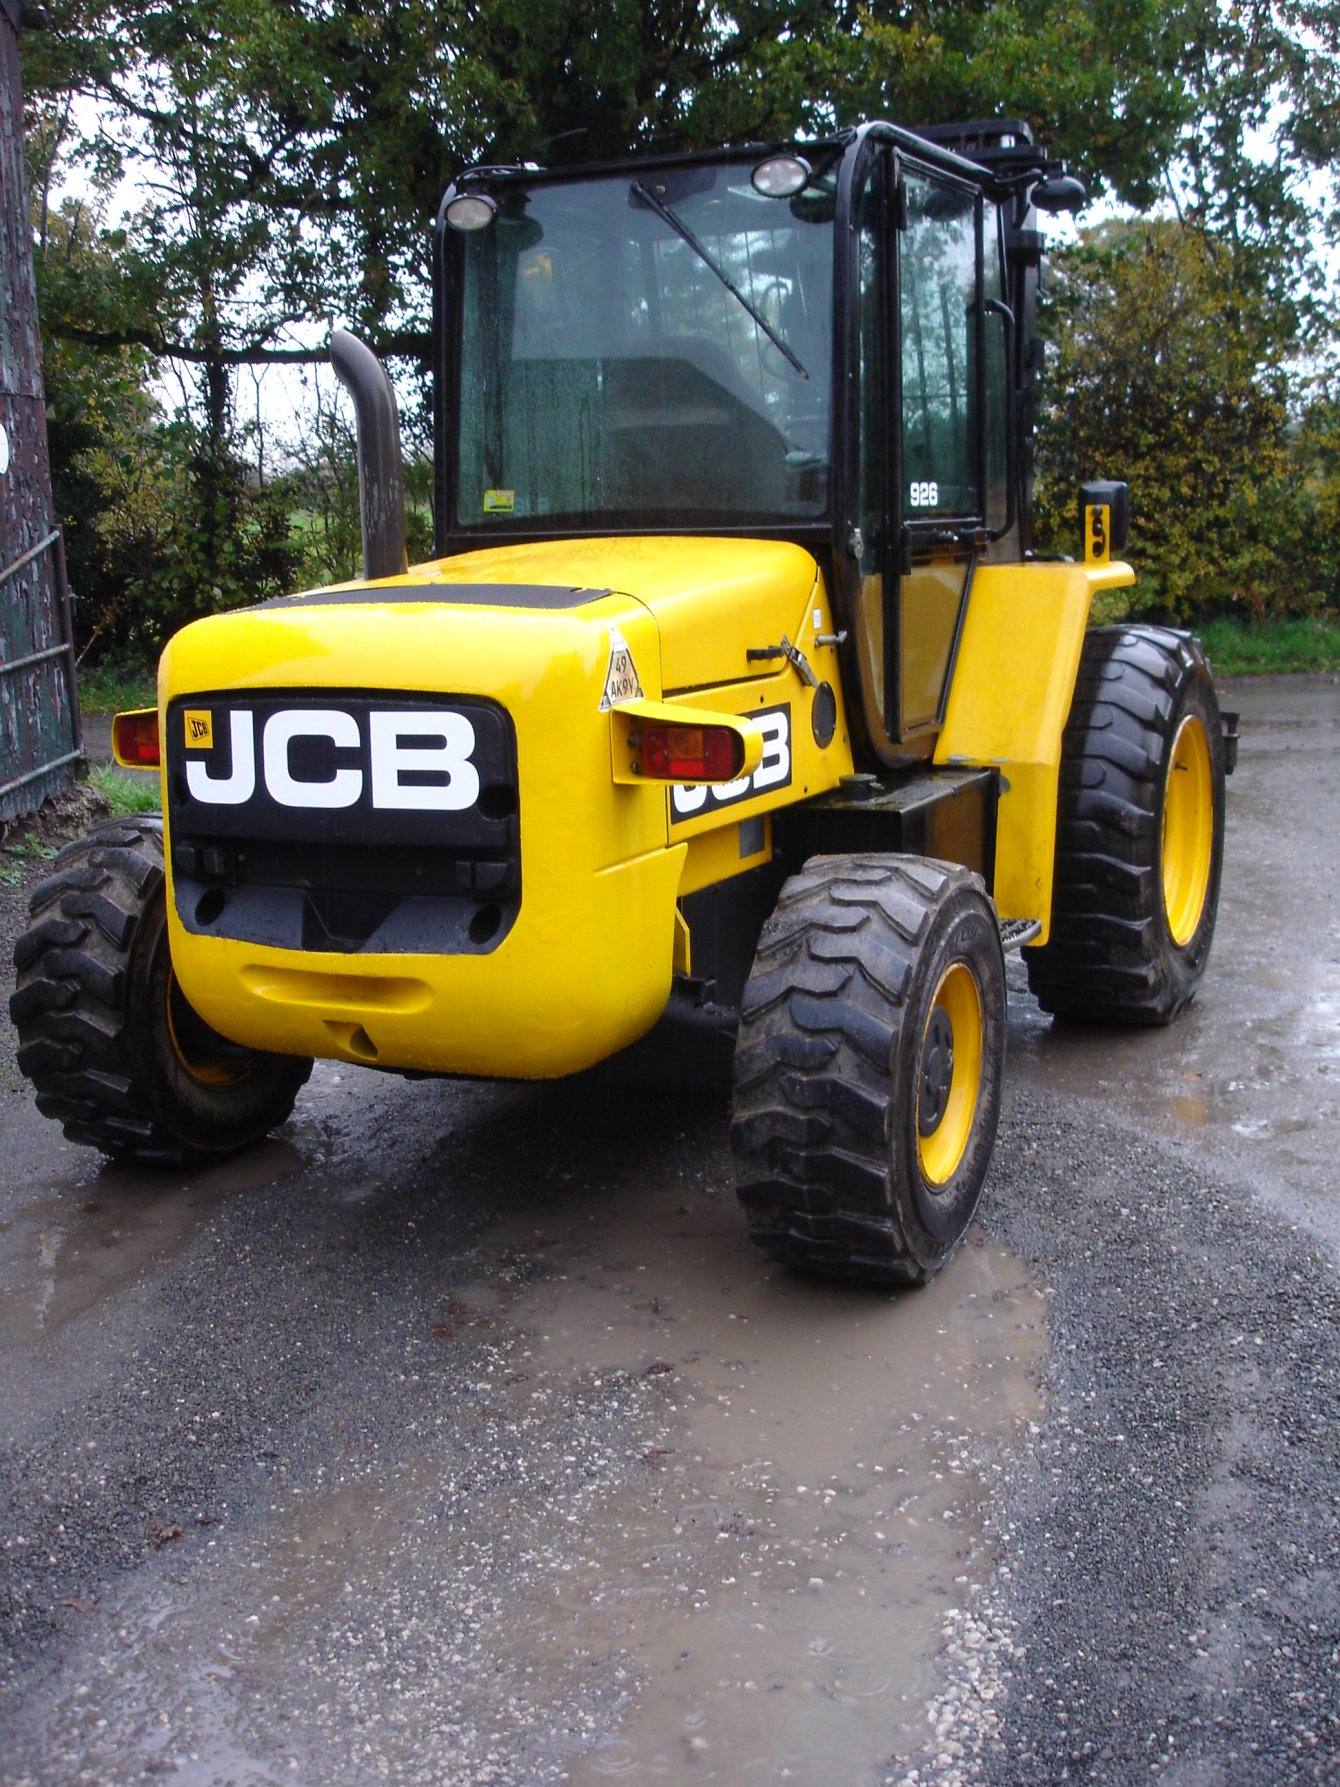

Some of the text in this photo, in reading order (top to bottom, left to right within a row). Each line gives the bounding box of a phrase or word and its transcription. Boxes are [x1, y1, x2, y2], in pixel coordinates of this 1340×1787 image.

[910, 481, 938, 507] 926
[615, 655, 628, 674] 49
[191, 719, 208, 738] JCB
[186, 709, 480, 811] JCB
